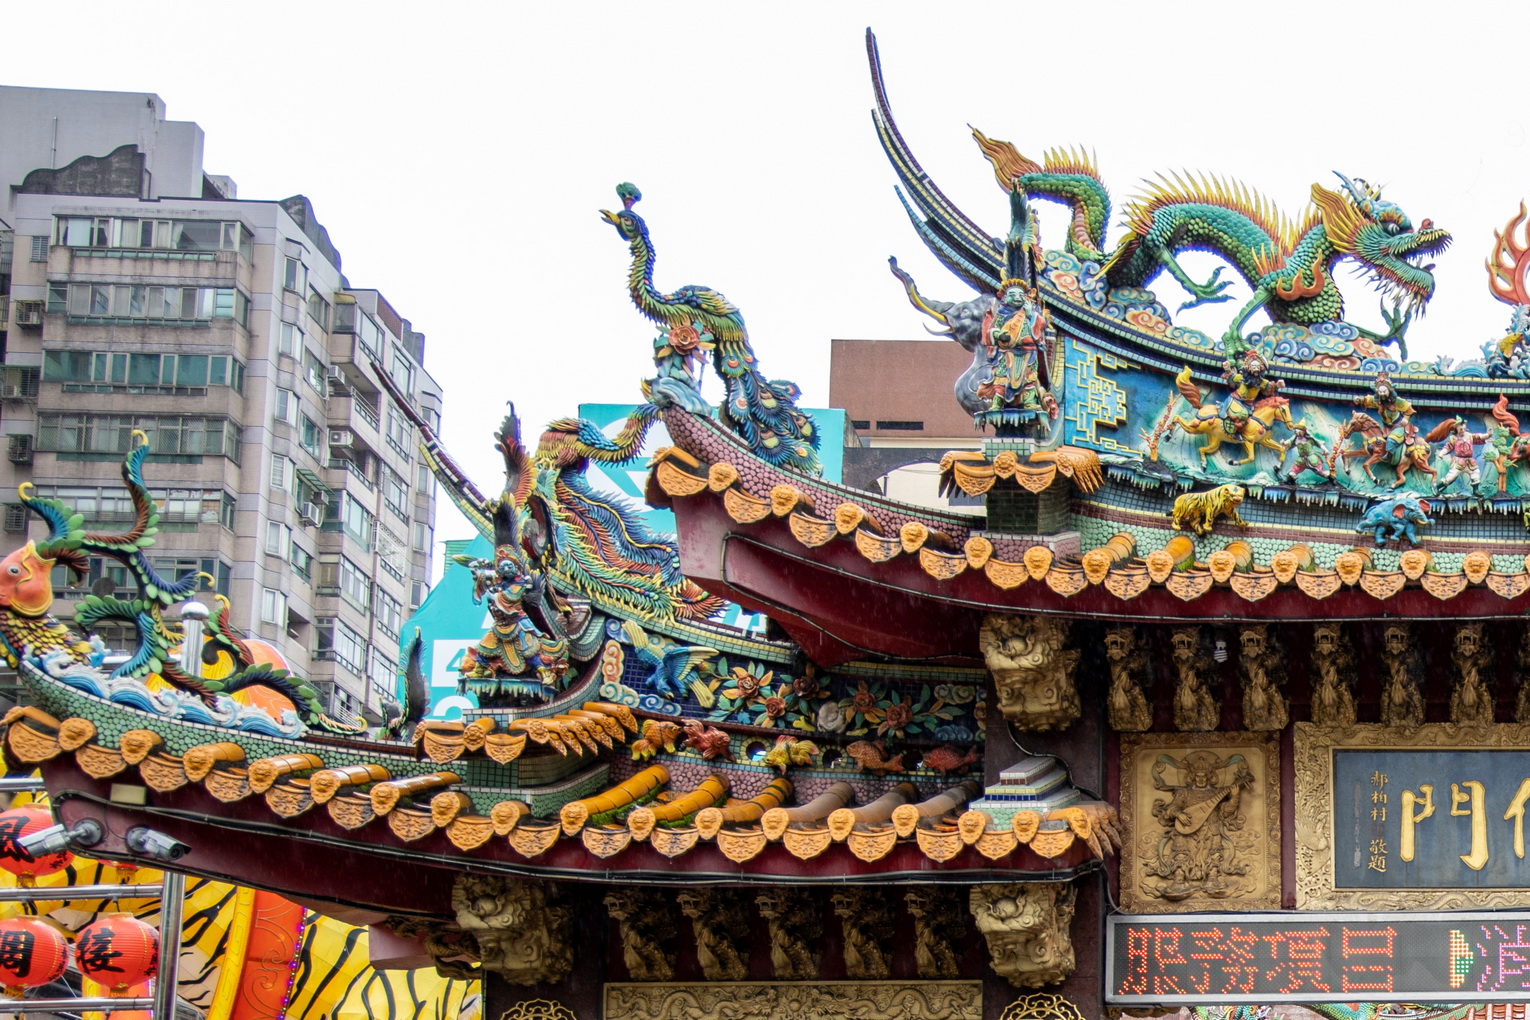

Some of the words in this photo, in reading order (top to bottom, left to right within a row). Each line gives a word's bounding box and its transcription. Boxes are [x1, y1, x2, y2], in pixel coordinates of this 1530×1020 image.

[76, 926, 126, 975] 接
[1118, 926, 1398, 996] 服務項目
